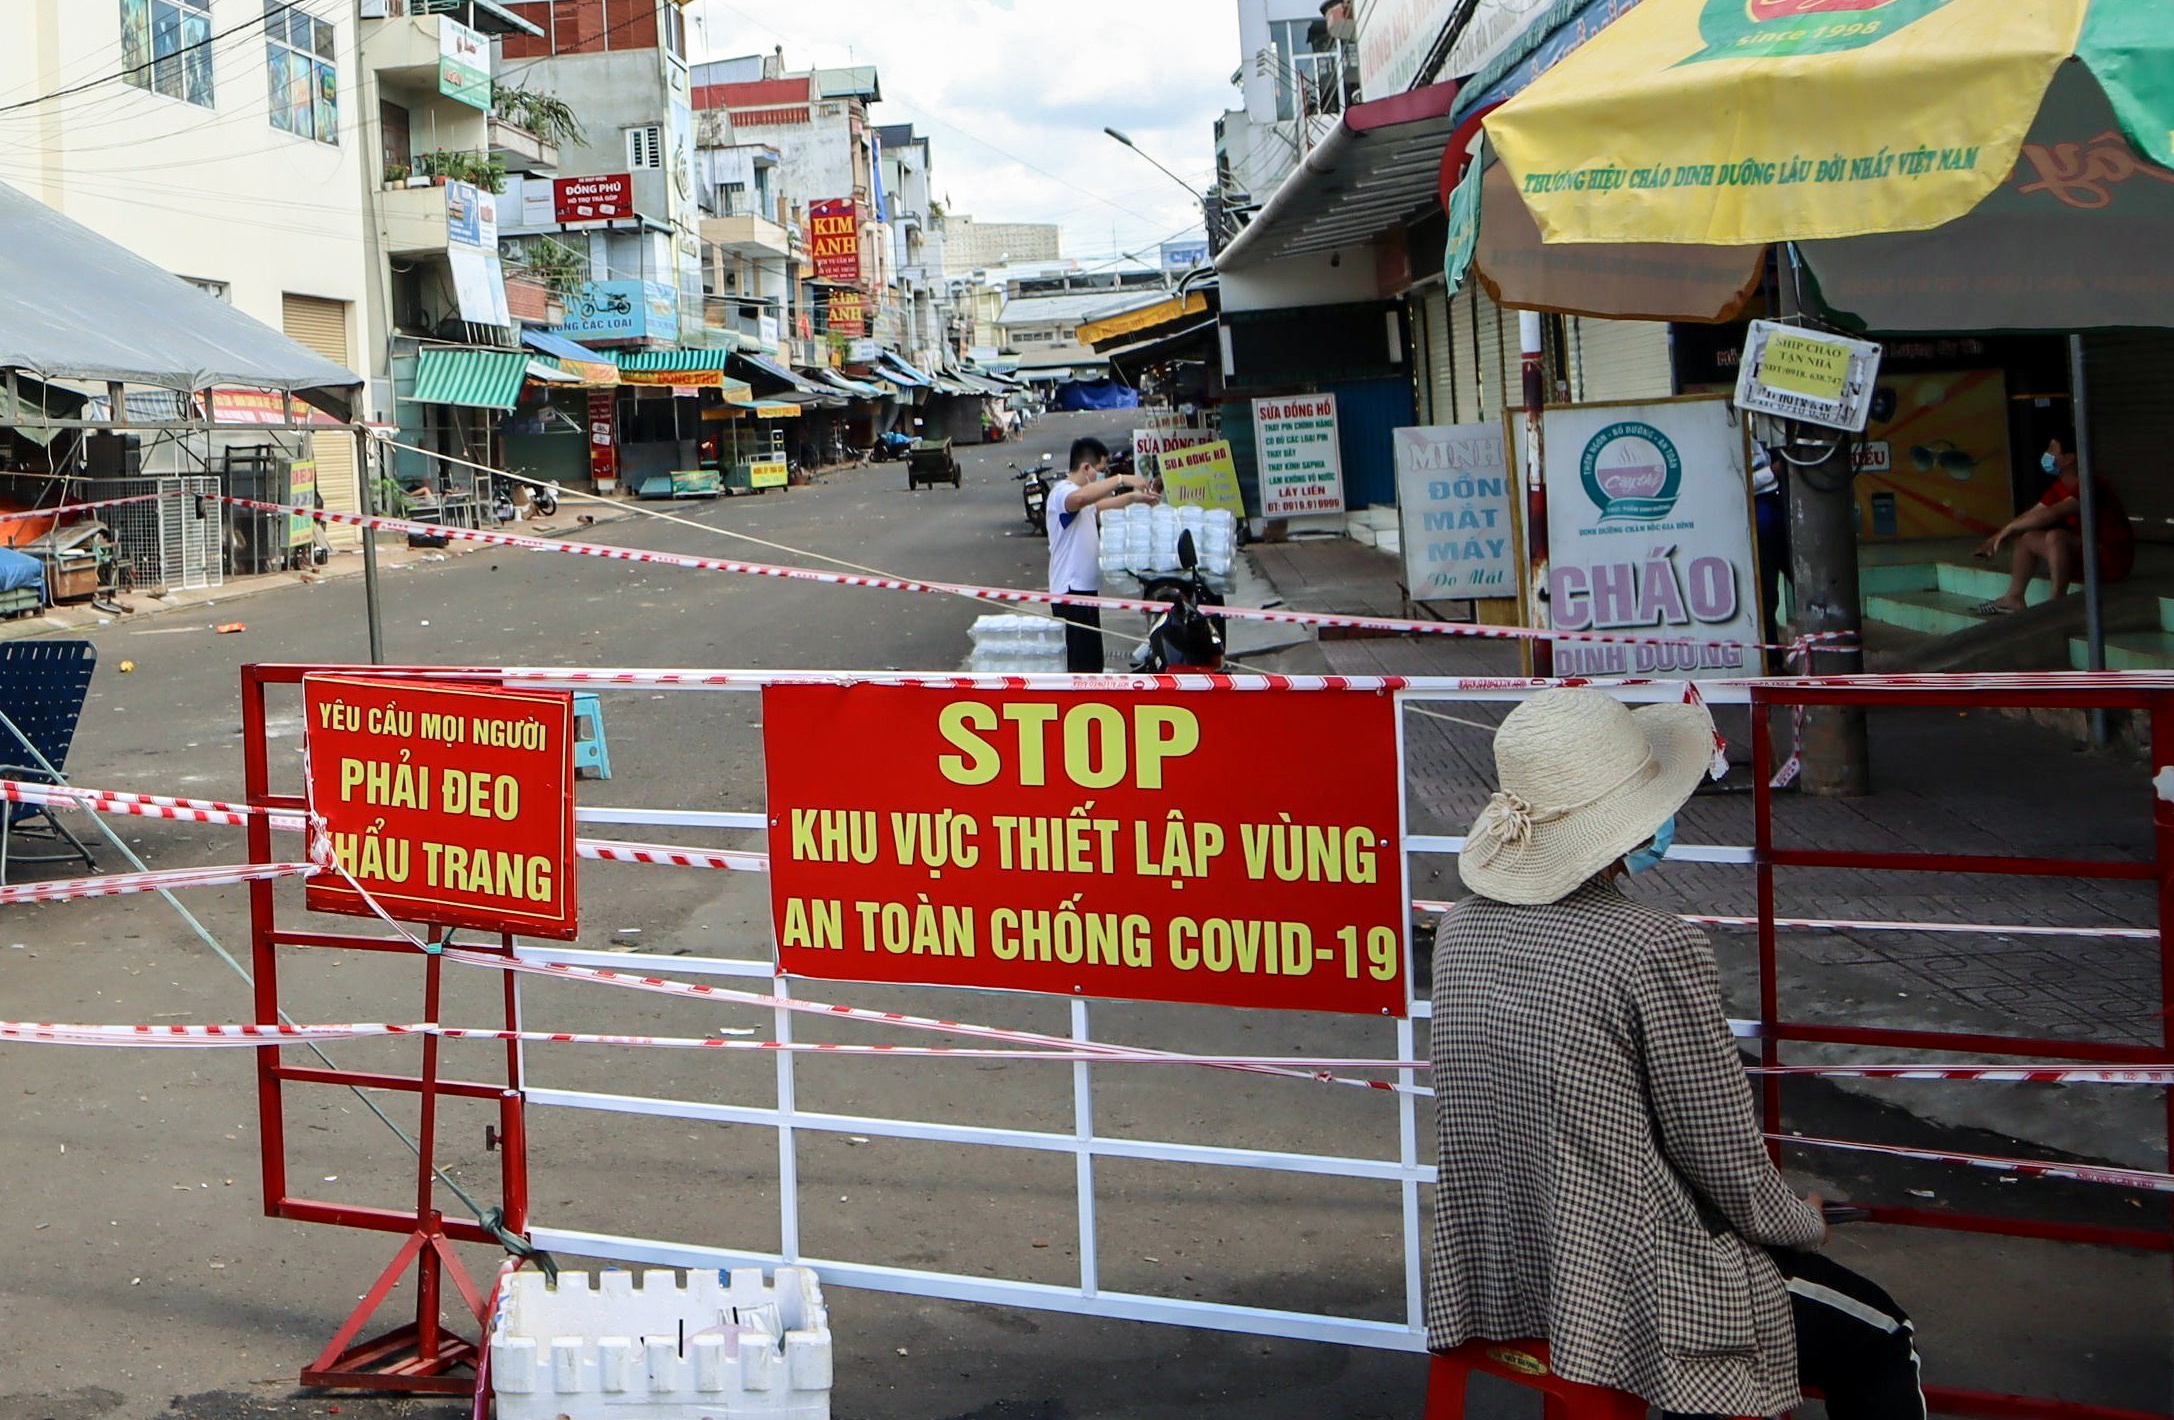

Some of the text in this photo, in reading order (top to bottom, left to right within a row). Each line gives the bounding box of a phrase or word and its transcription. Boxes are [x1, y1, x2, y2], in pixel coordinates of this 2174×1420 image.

[1813, 19, 1882, 39] 1998
[1524, 170, 1587, 194] THƯƠNG
[1586, 166, 1625, 195] HIỆU
[1627, 162, 1672, 188] CHÁO
[1673, 165, 1713, 187] DINH
[1715, 157, 1776, 187] DƯỠNG
[1777, 158, 1810, 184] LÂU
[1897, 145, 1936, 180] VIỆT
[1936, 147, 1982, 171] NAM
[813, 215, 854, 236] KIM
[814, 236, 857, 257] ANH
[828, 305, 863, 321] ANH
[1775, 338, 1804, 350] SHIP
[1316, 432, 1328, 442] PIN
[1428, 472, 1510, 501] ĐỒN
[1423, 502, 1499, 532] MẮT
[1427, 536, 1505, 562] MÁY
[1550, 545, 1738, 631] CHÁO
[1554, 643, 1628, 677] DINH
[319, 699, 547, 752] YÊU CẦU MỌI NGƯỜI
[937, 699, 1200, 790] STOP
[340, 747, 520, 822] PHẢI ĐEO
[325, 817, 552, 903] HẨU TRANG
[790, 800, 1378, 890] KHU VỰC THIẾT LẬP VÙNG
[782, 892, 1398, 982] AN TOÀN CHỐNG COVID-19
